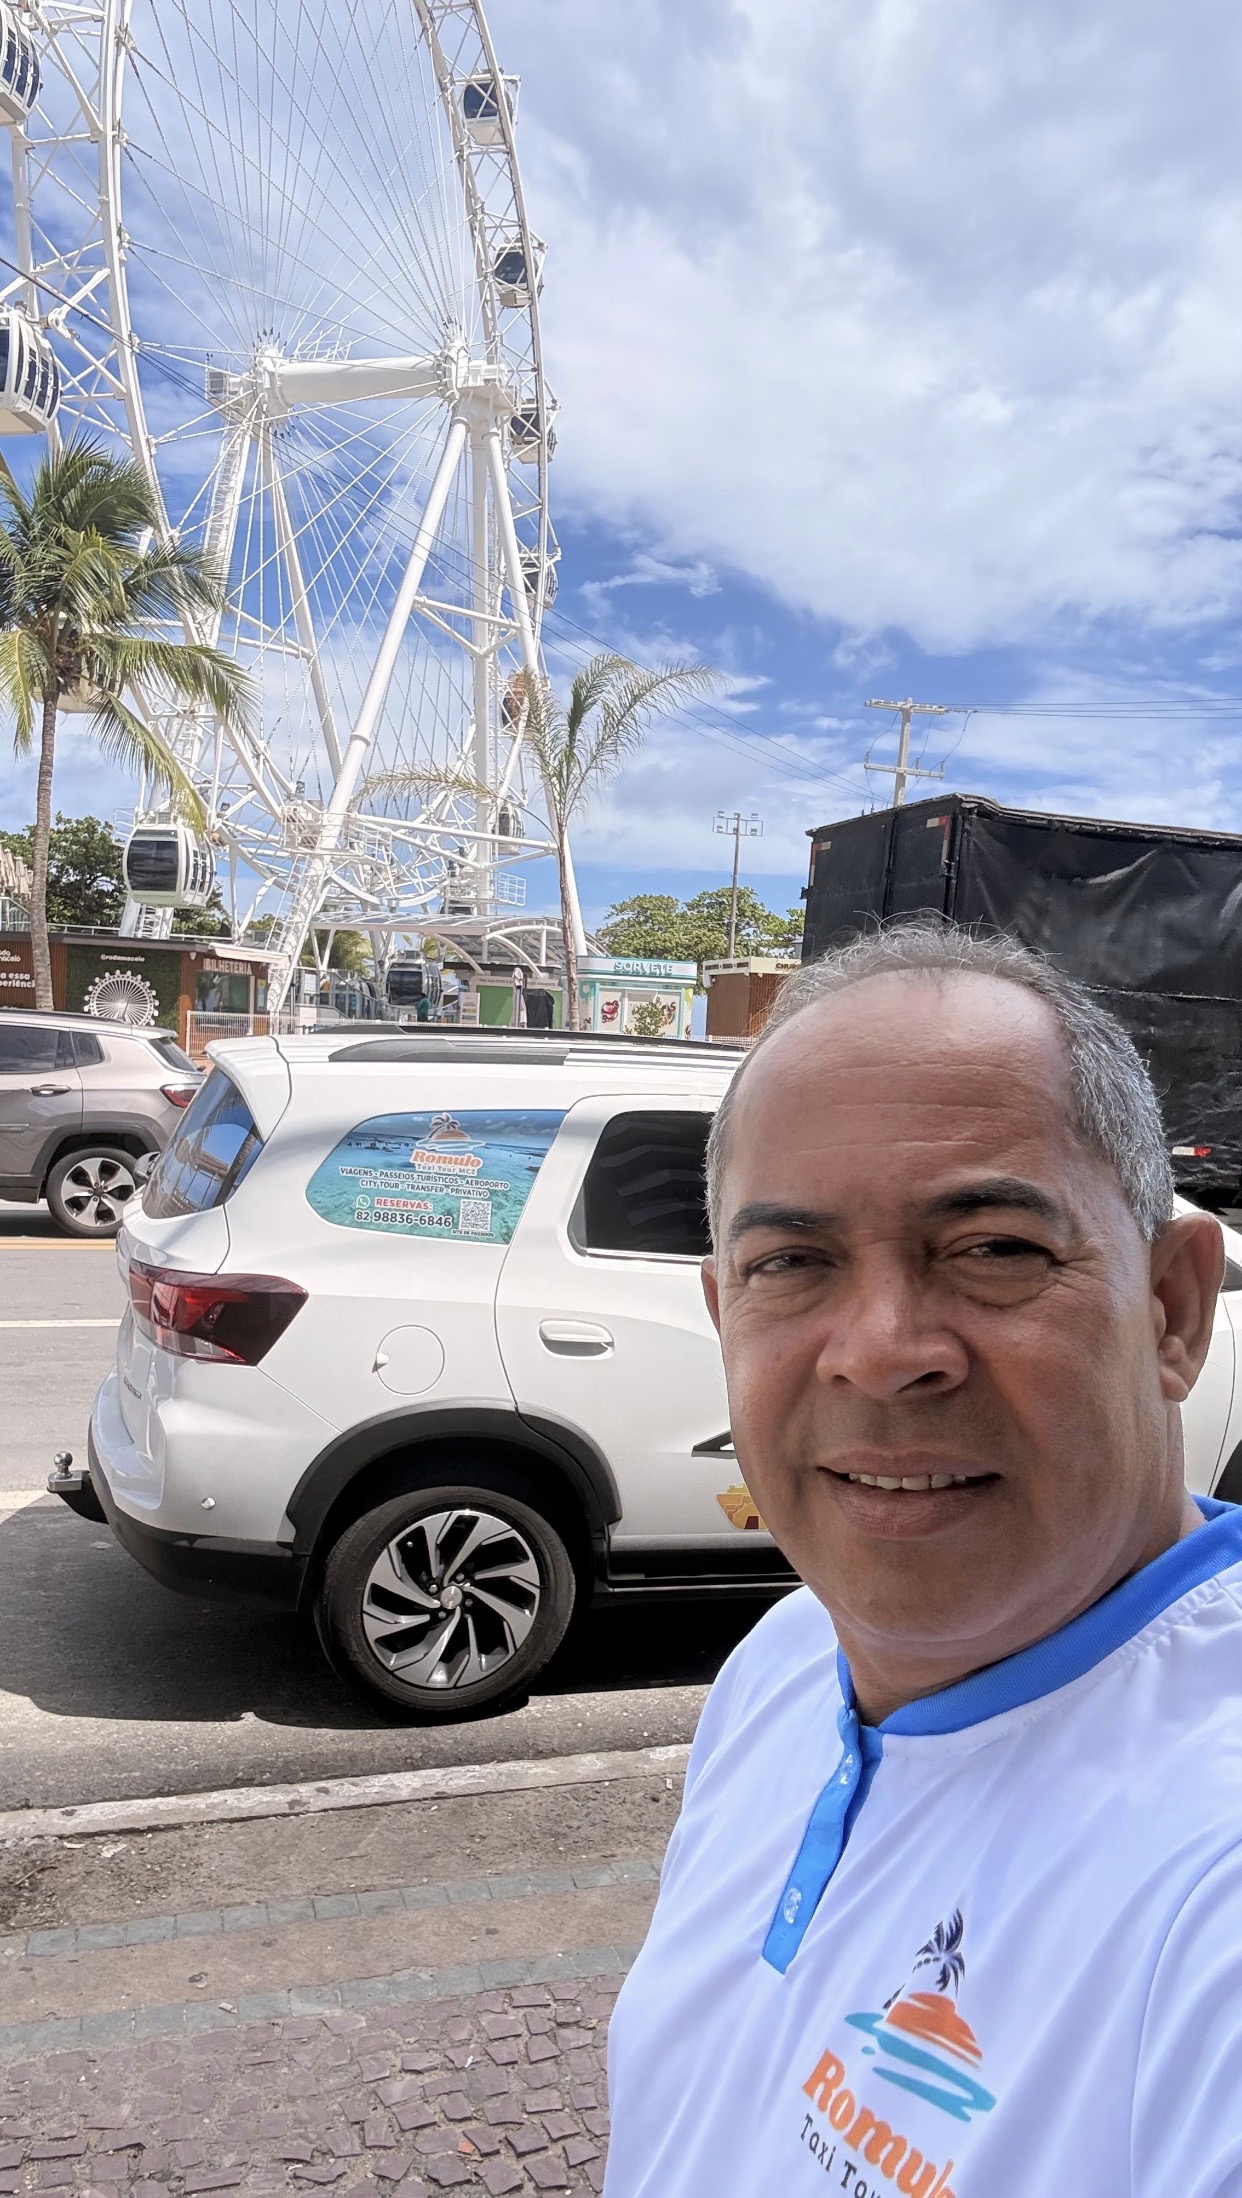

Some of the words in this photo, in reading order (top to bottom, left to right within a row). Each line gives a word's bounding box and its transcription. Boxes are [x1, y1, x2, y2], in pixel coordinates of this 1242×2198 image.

[203, 958, 253, 976] BILHETERIA
[614, 961, 673, 974] SORVETE
[8, 972, 31, 981] essa
[412, 1150, 482, 1168] Romulo
[340, 1167, 373, 1177] VIAGENS
[379, 1171, 415, 1181] PASSEIOS
[417, 1173, 459, 1185] TURÍSTICOS
[464, 1179, 510, 1190] AEROPORTO
[437, 1165, 457, 1173] Tour
[459, 1167, 476, 1175] MCZ
[360, 1179, 378, 1188] CITY
[380, 1181, 400, 1190] TOUR
[406, 1183, 445, 1193] TRANSFER
[450, 1187, 489, 1198] PRIVATIVO
[376, 1198, 433, 1211] RESERVAS:
[356, 1211, 370, 1221] 82
[373, 1211, 452, 1228] 98836-6846
[800, 2113, 837, 2173] Taxi
